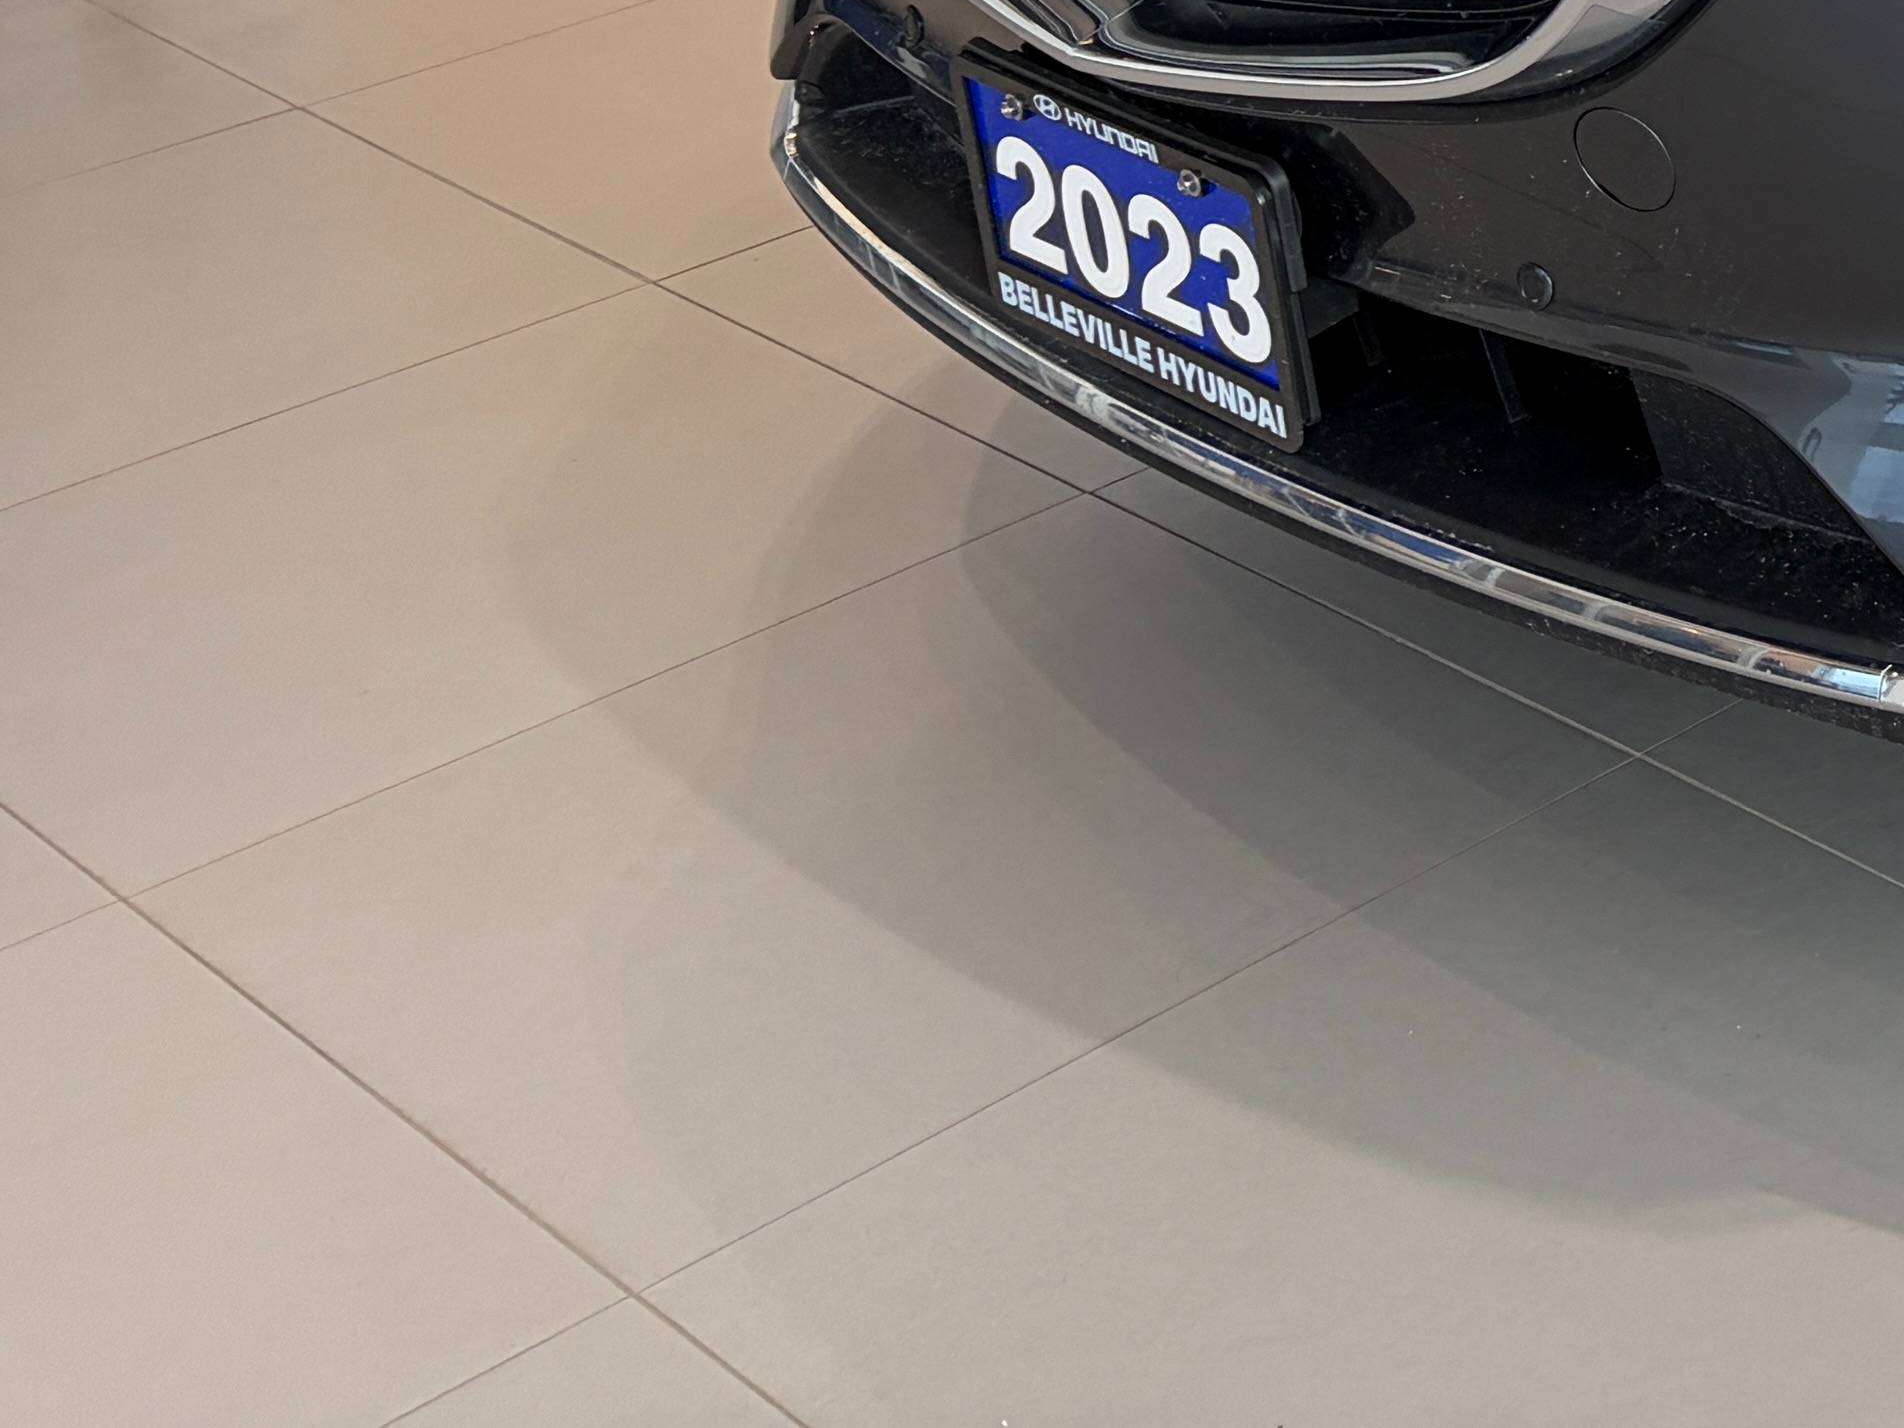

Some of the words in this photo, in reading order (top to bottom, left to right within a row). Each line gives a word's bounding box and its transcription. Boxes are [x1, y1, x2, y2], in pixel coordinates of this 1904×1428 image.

[1063, 106, 1160, 165] HYUNDAI
[996, 135, 1273, 364] 2023
[997, 271, 1156, 375] BELLEVILLE
[1156, 346, 1288, 440] HYUNDAI
